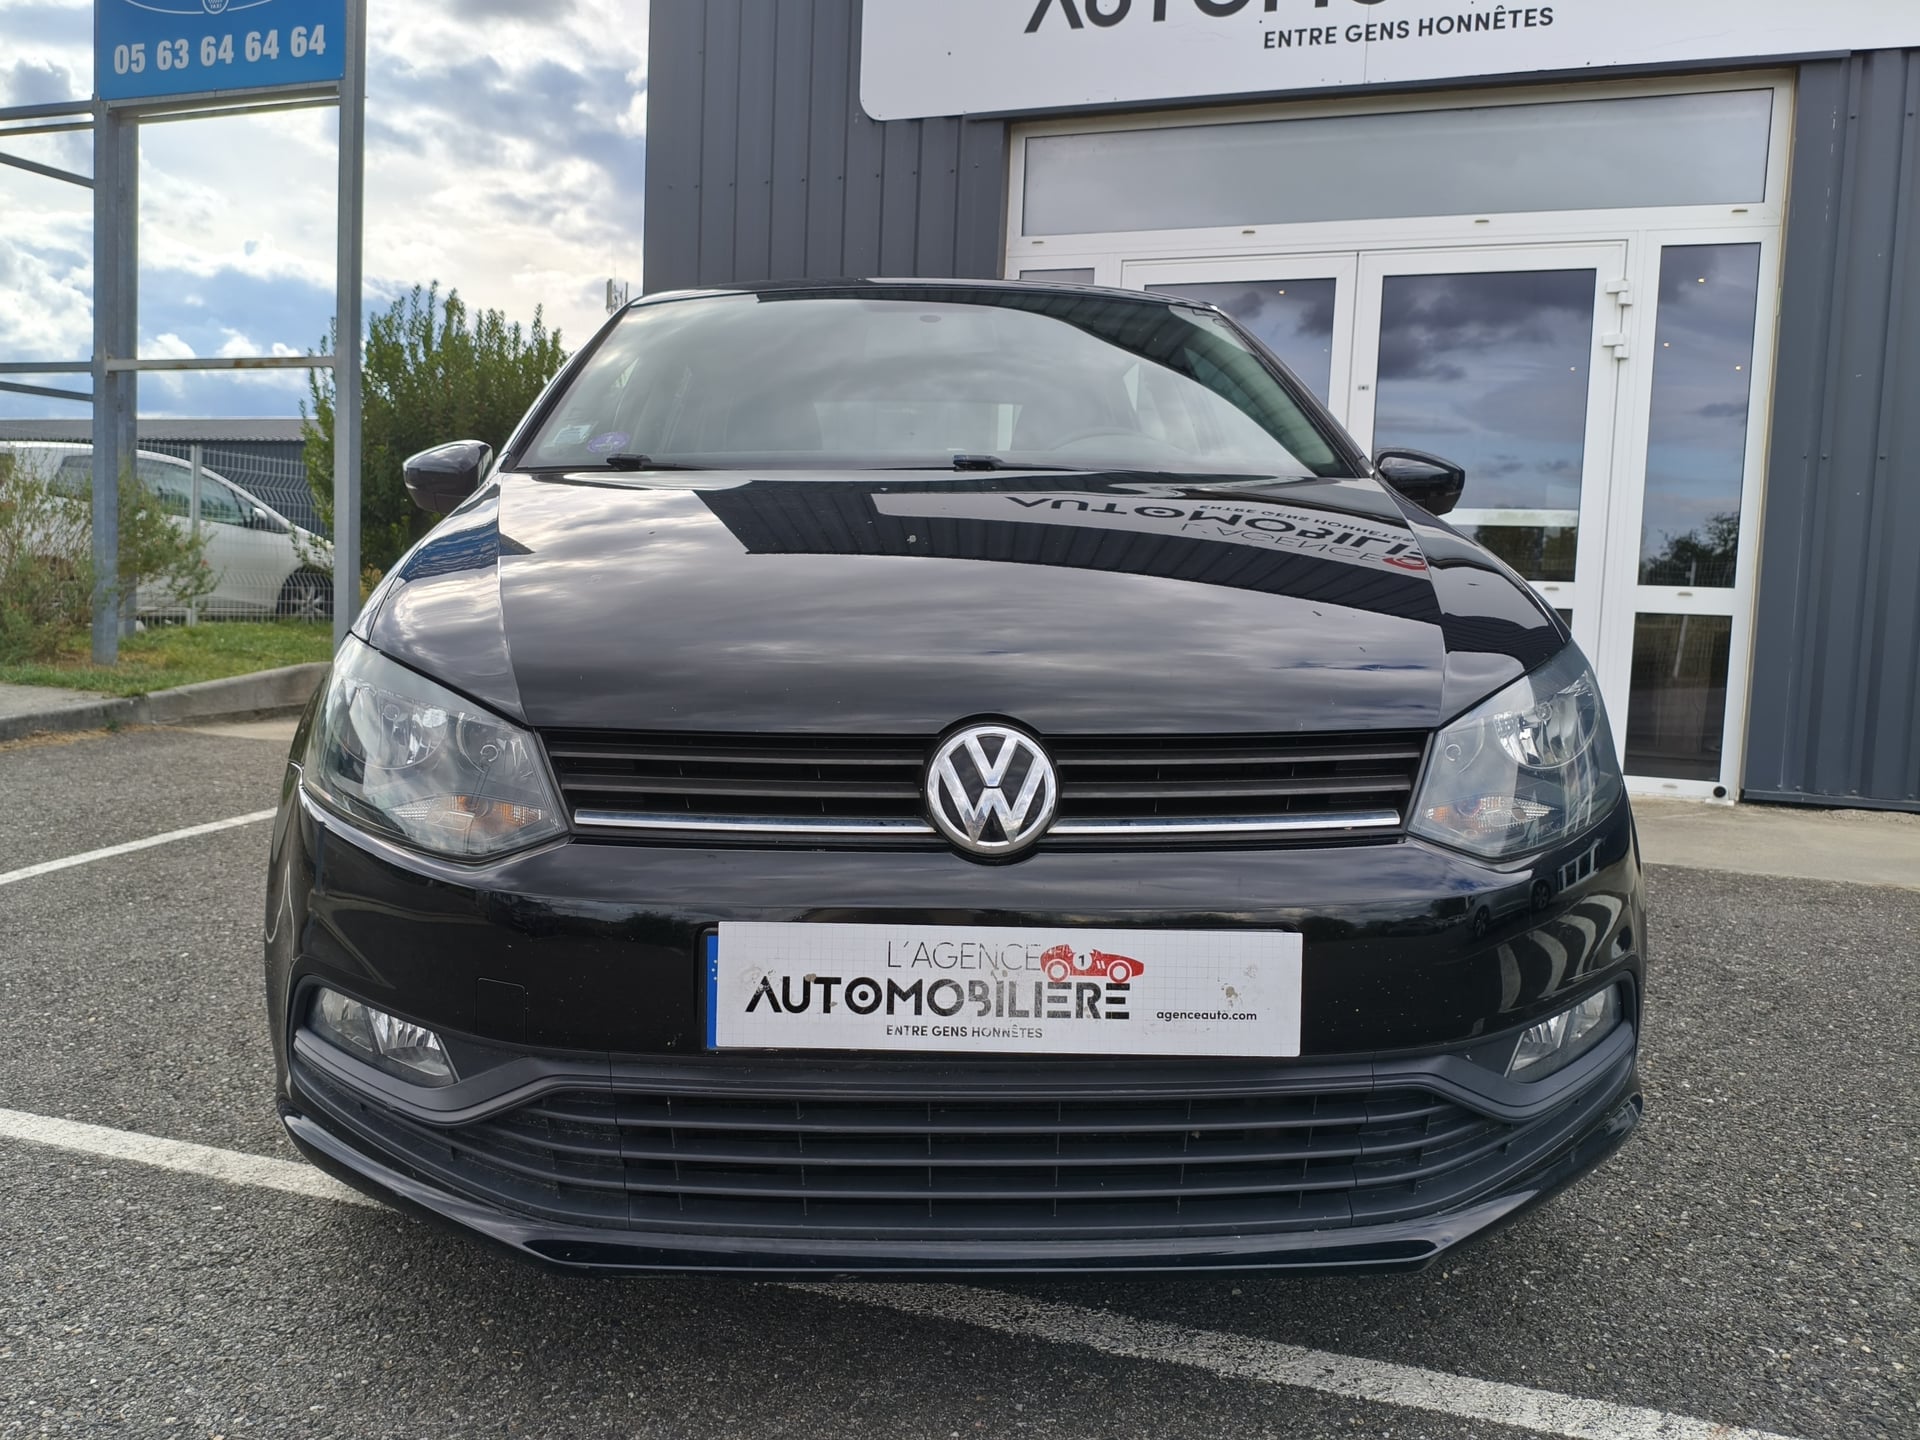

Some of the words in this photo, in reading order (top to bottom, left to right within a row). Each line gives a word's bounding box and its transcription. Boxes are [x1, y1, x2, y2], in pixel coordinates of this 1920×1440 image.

[1264, 26, 1337, 49] ENTRE
[1345, 20, 1410, 43] GENS
[1418, 5, 1554, 37] HONNÊTES
[114, 43, 146, 75] 05
[157, 38, 190, 71] 63
[200, 34, 235, 67] 64
[245, 29, 280, 62] 64
[290, 24, 326, 58] 64
[887, 940, 1041, 971] L'AGENCE
[886, 1025, 928, 1037] ENTRE
[931, 1025, 968, 1038] GENS
[971, 1024, 1043, 1039] HONNÊTES
[1156, 1010, 1257, 1022] agenceauto.com
